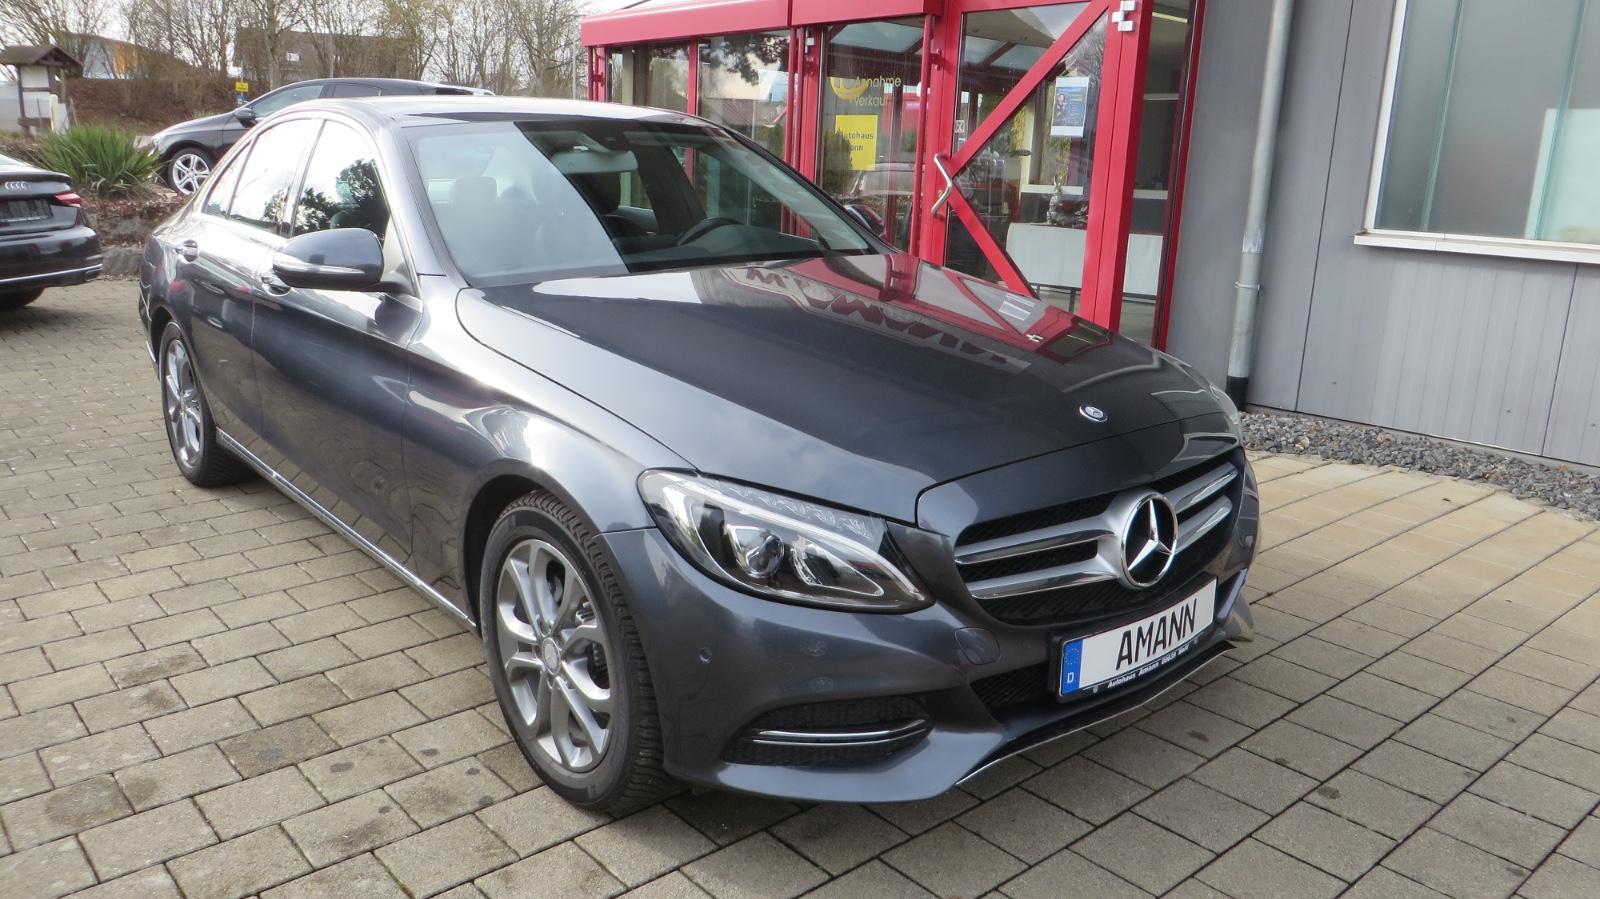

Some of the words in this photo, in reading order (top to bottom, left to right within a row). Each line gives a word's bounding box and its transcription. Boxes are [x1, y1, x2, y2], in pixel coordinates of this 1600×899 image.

[1115, 598, 1198, 671] AMANN
[1067, 671, 1075, 684] D
[1107, 673, 1136, 689] Autohaus
